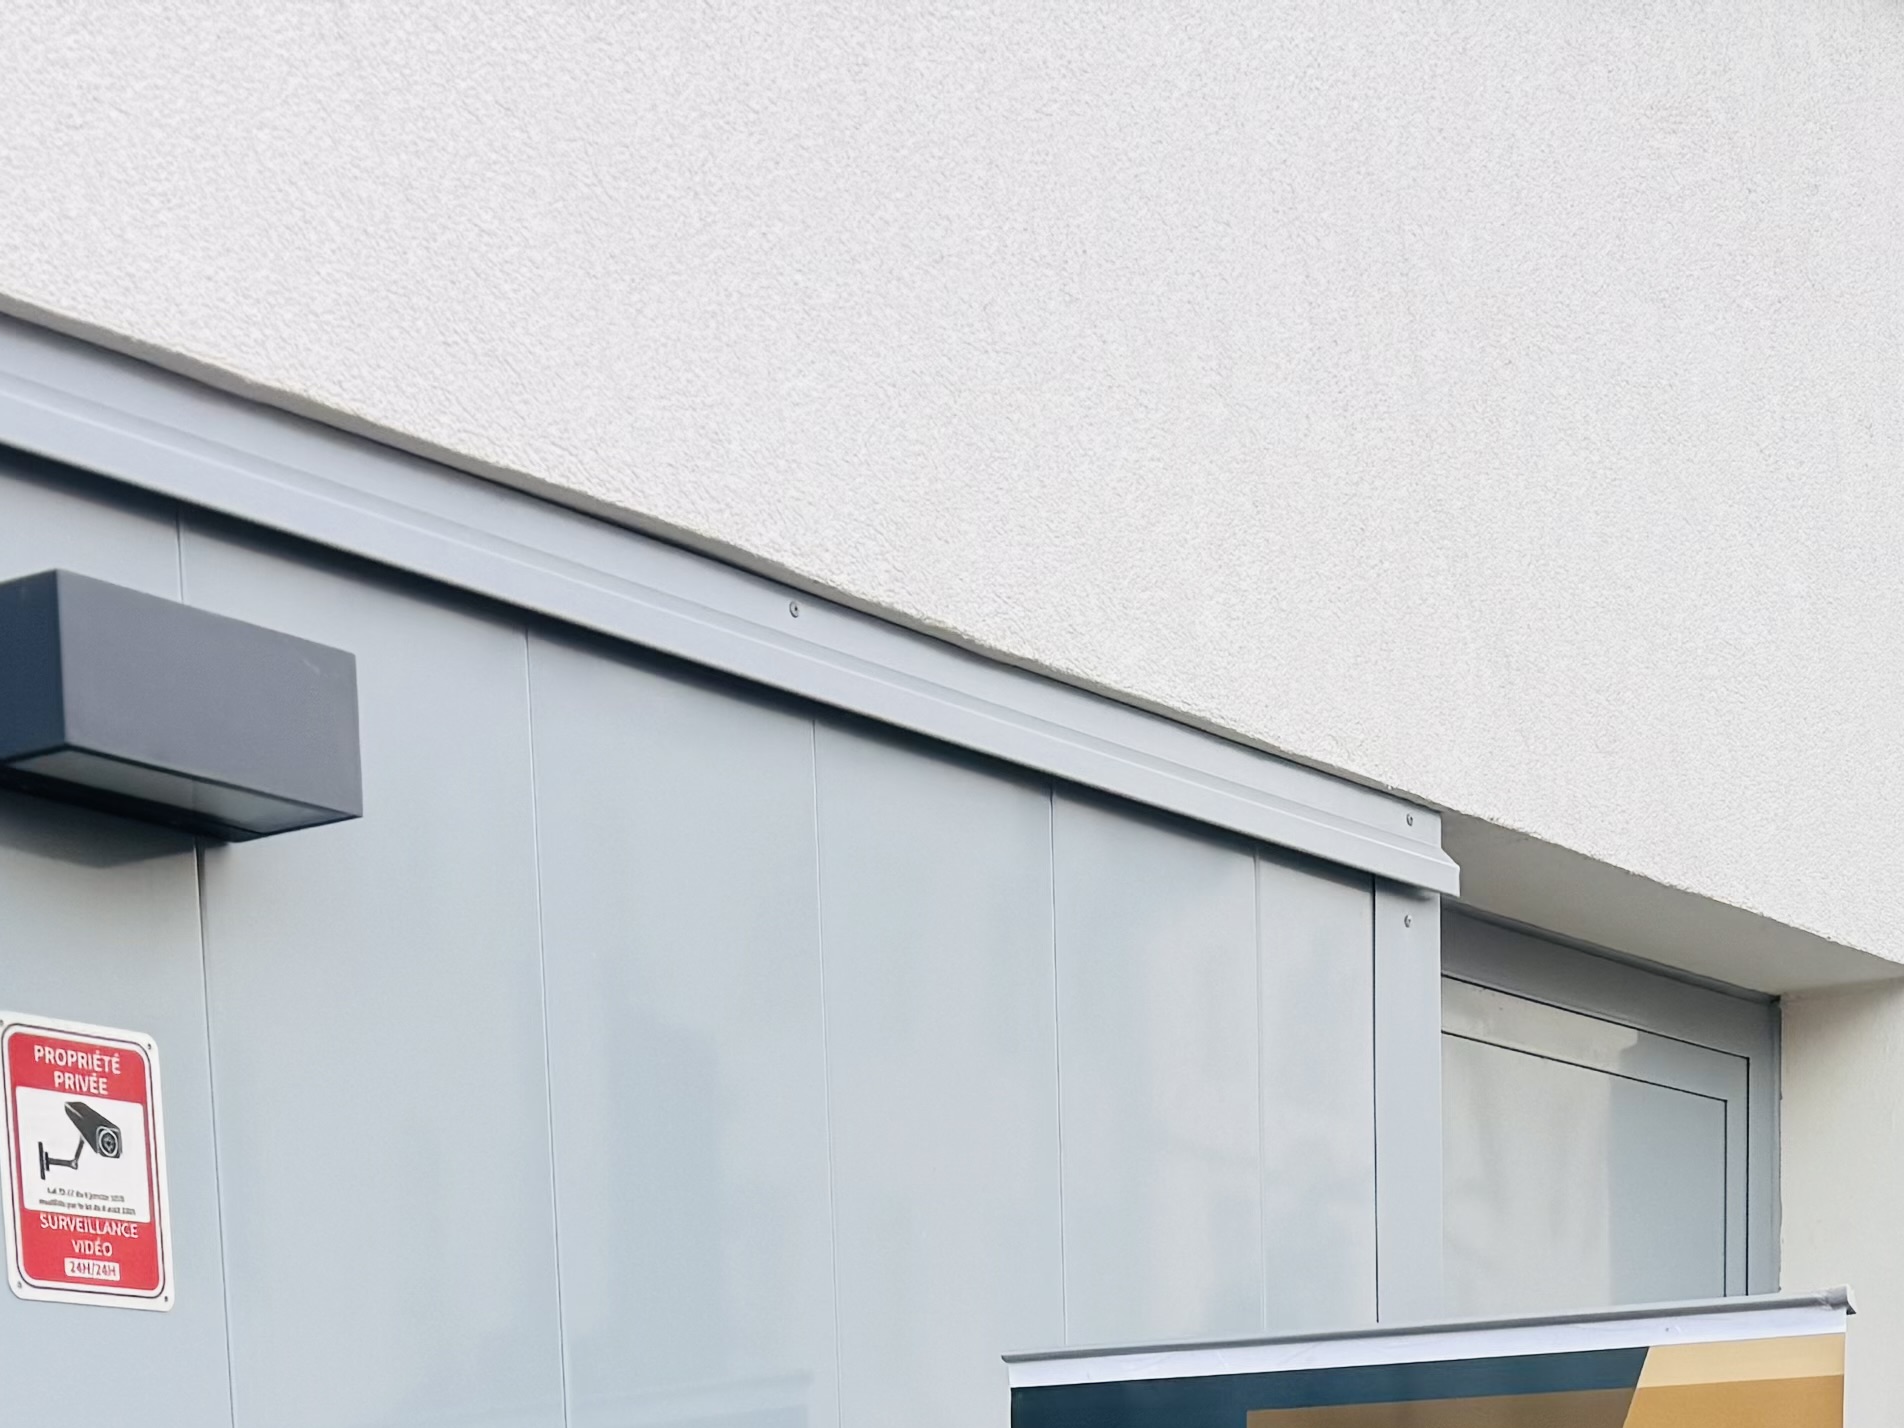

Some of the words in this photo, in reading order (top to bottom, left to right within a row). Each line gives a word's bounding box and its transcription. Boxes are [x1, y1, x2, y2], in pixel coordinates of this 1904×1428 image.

[33, 1044, 121, 1075] PROPRIÉTÉ
[53, 1070, 109, 1095] PRIVÉE
[40, 1214, 139, 1239] SURVEILLANCE
[71, 1237, 113, 1257] VIDÉO
[69, 1260, 117, 1277] 24H/24H
